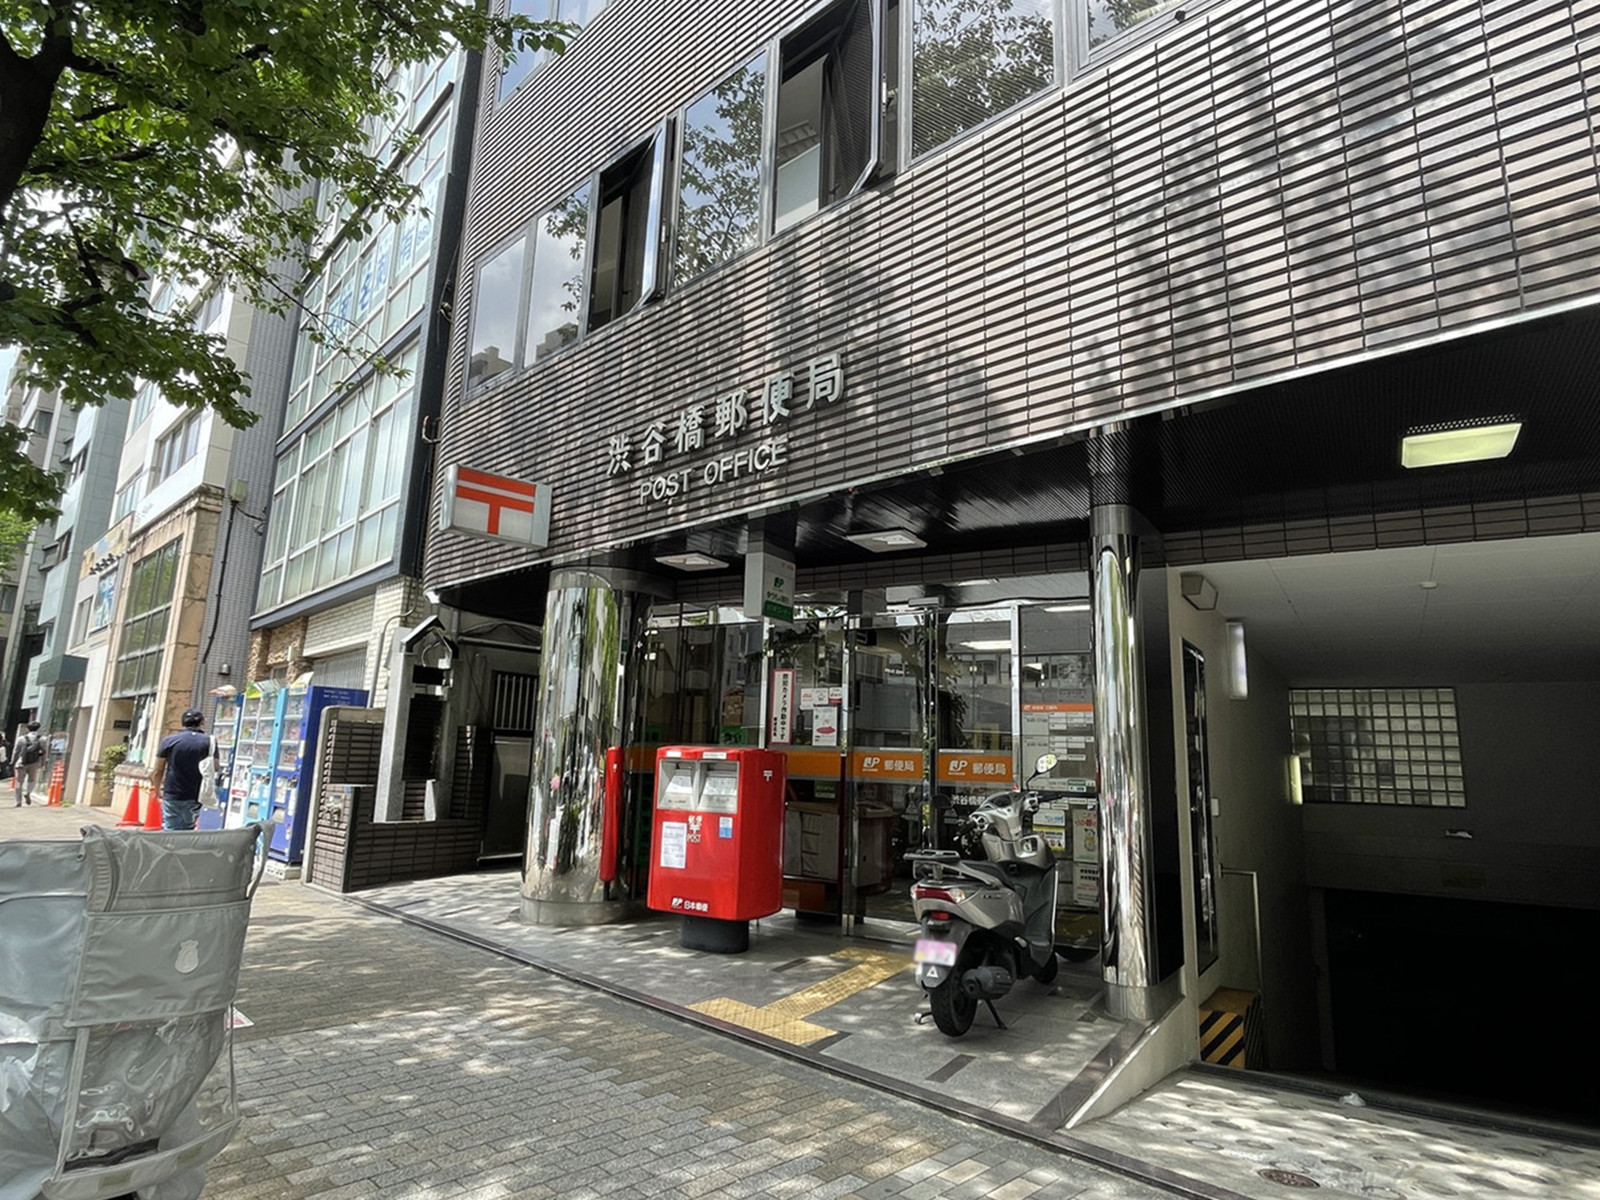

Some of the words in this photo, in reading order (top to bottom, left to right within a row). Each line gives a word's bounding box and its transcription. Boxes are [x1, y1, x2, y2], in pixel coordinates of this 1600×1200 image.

[606, 352, 844, 477] 渋谷橋郵便局
[639, 468, 693, 505] POST
[703, 437, 789, 485] OFFICE
[884, 759, 915, 772] 郵便局
[972, 762, 1007, 776] 郵便局
